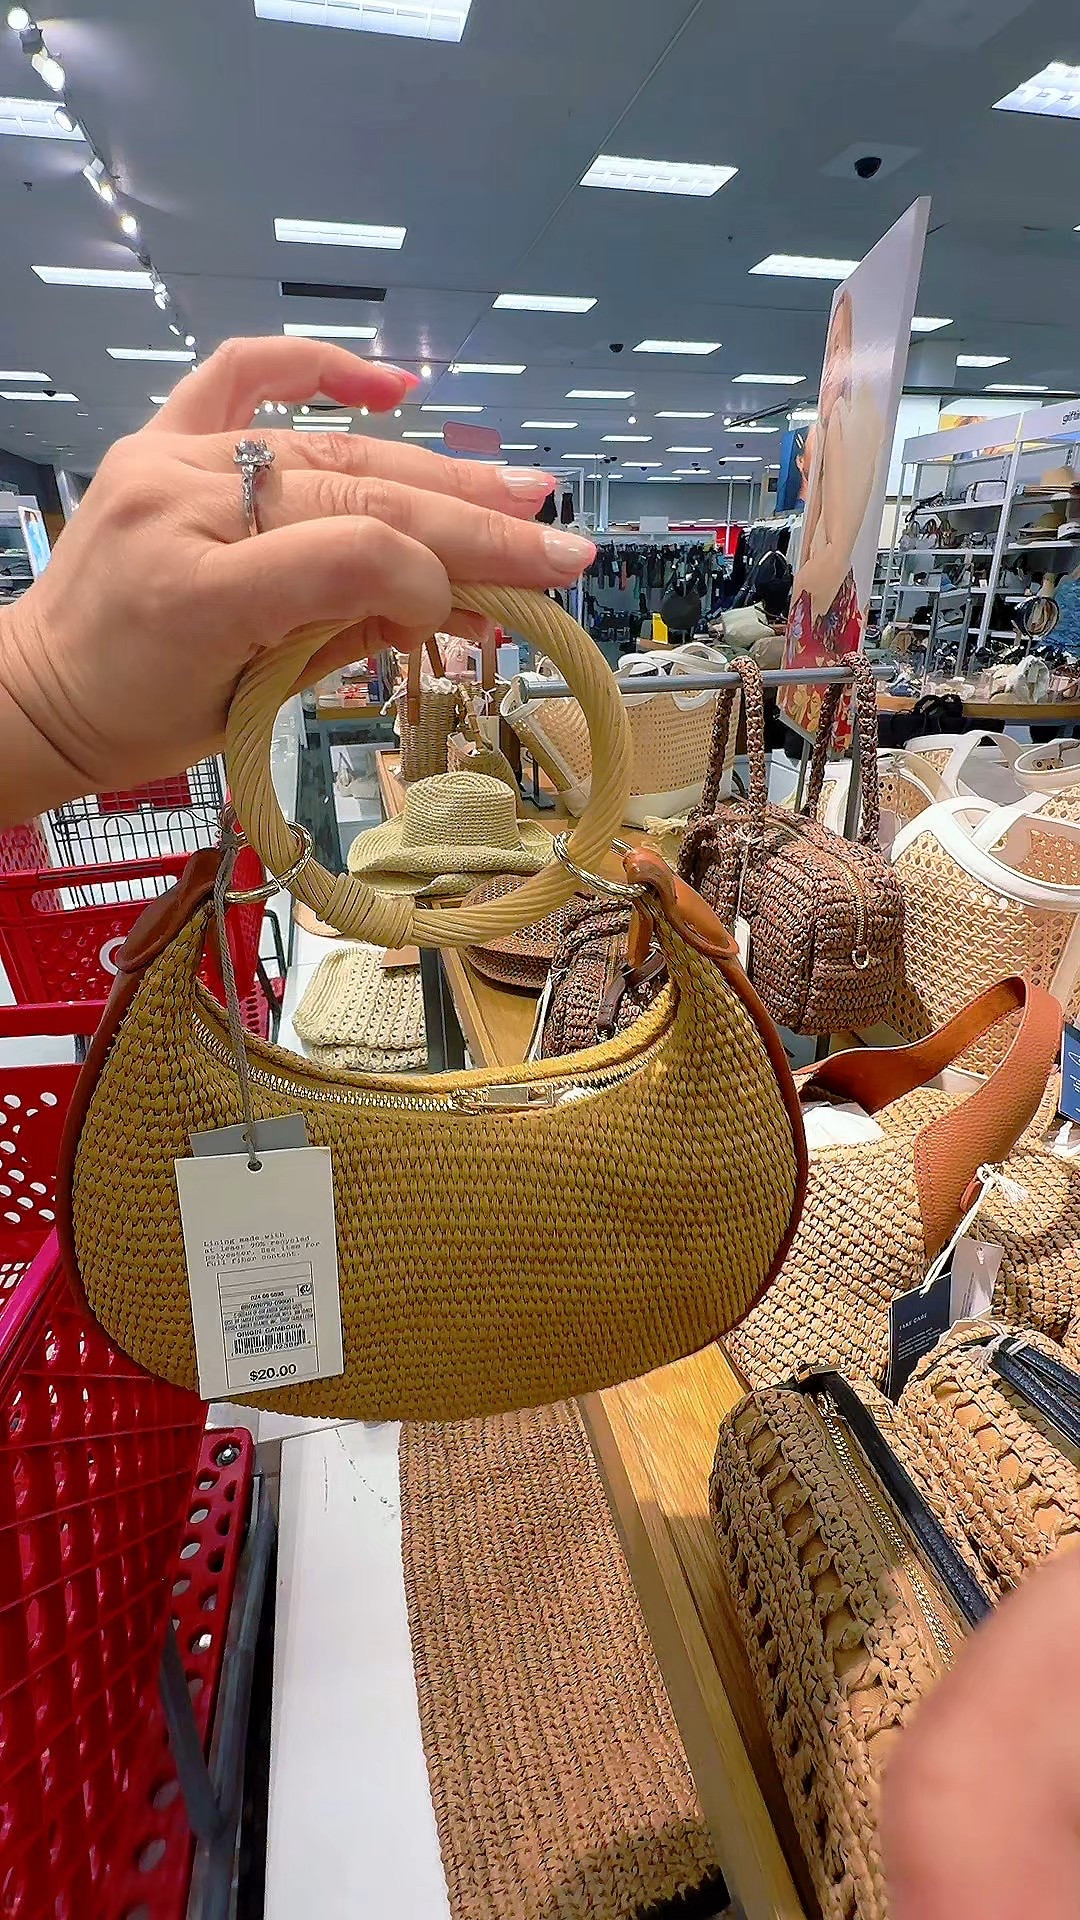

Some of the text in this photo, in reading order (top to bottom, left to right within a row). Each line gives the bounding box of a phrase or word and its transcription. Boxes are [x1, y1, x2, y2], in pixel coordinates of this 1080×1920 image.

[203, 1238, 235, 1247] Lining
[239, 1235, 260, 1243] made
[271, 1235, 310, 1245] recycled
[206, 1251, 300, 1267] full fiber content.
[249, 1363, 297, 1381] $20.00
